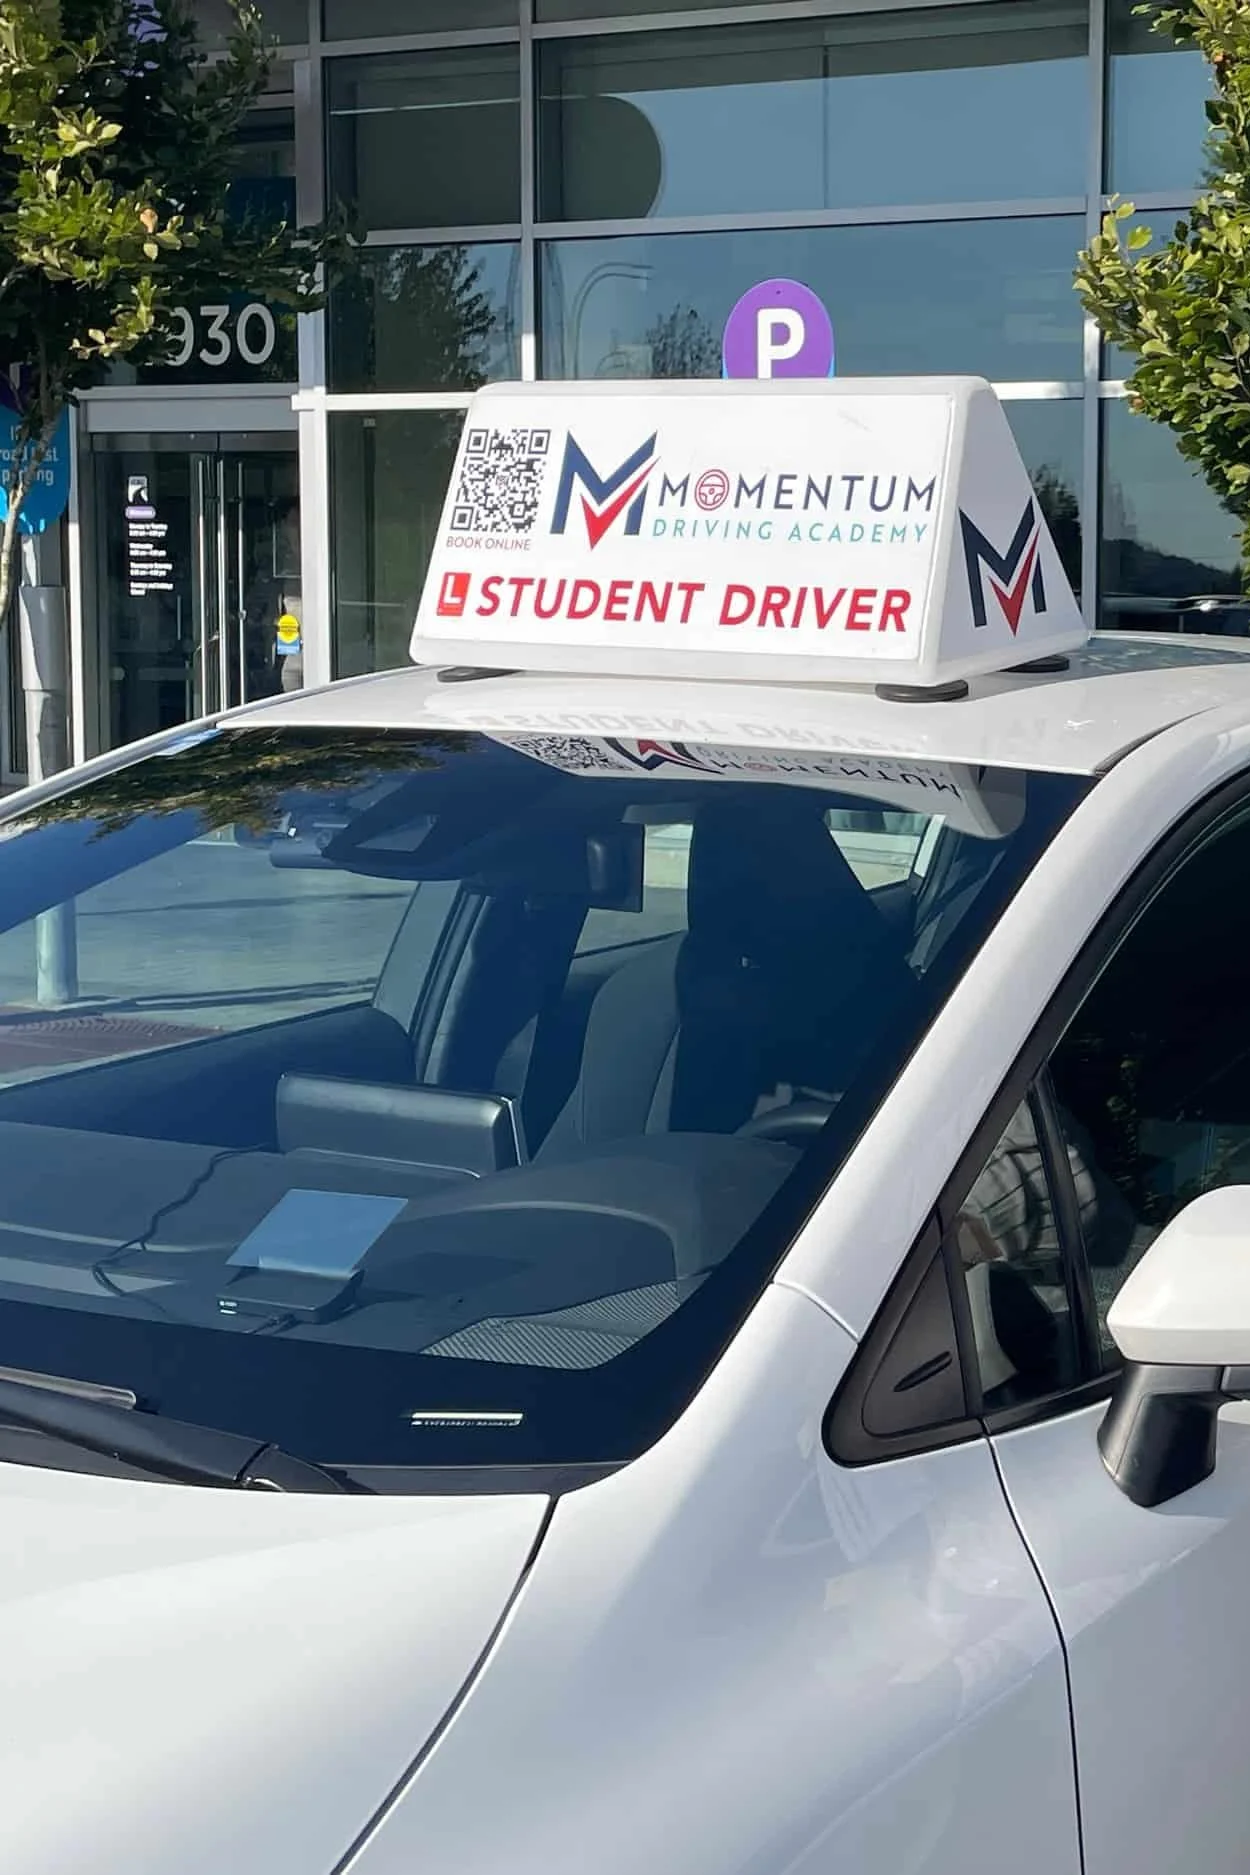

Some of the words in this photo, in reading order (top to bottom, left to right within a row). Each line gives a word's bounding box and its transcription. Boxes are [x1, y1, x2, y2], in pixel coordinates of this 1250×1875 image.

[757, 307, 805, 379] P
[658, 469, 937, 512] MOMENTUM
[446, 536, 482, 549] BOOK
[484, 538, 531, 551] ONLINE
[652, 519, 773, 540] DRIVING
[788, 523, 928, 543] ACADEMY
[476, 576, 705, 623] STUDENT
[719, 584, 912, 632] DRIVER
